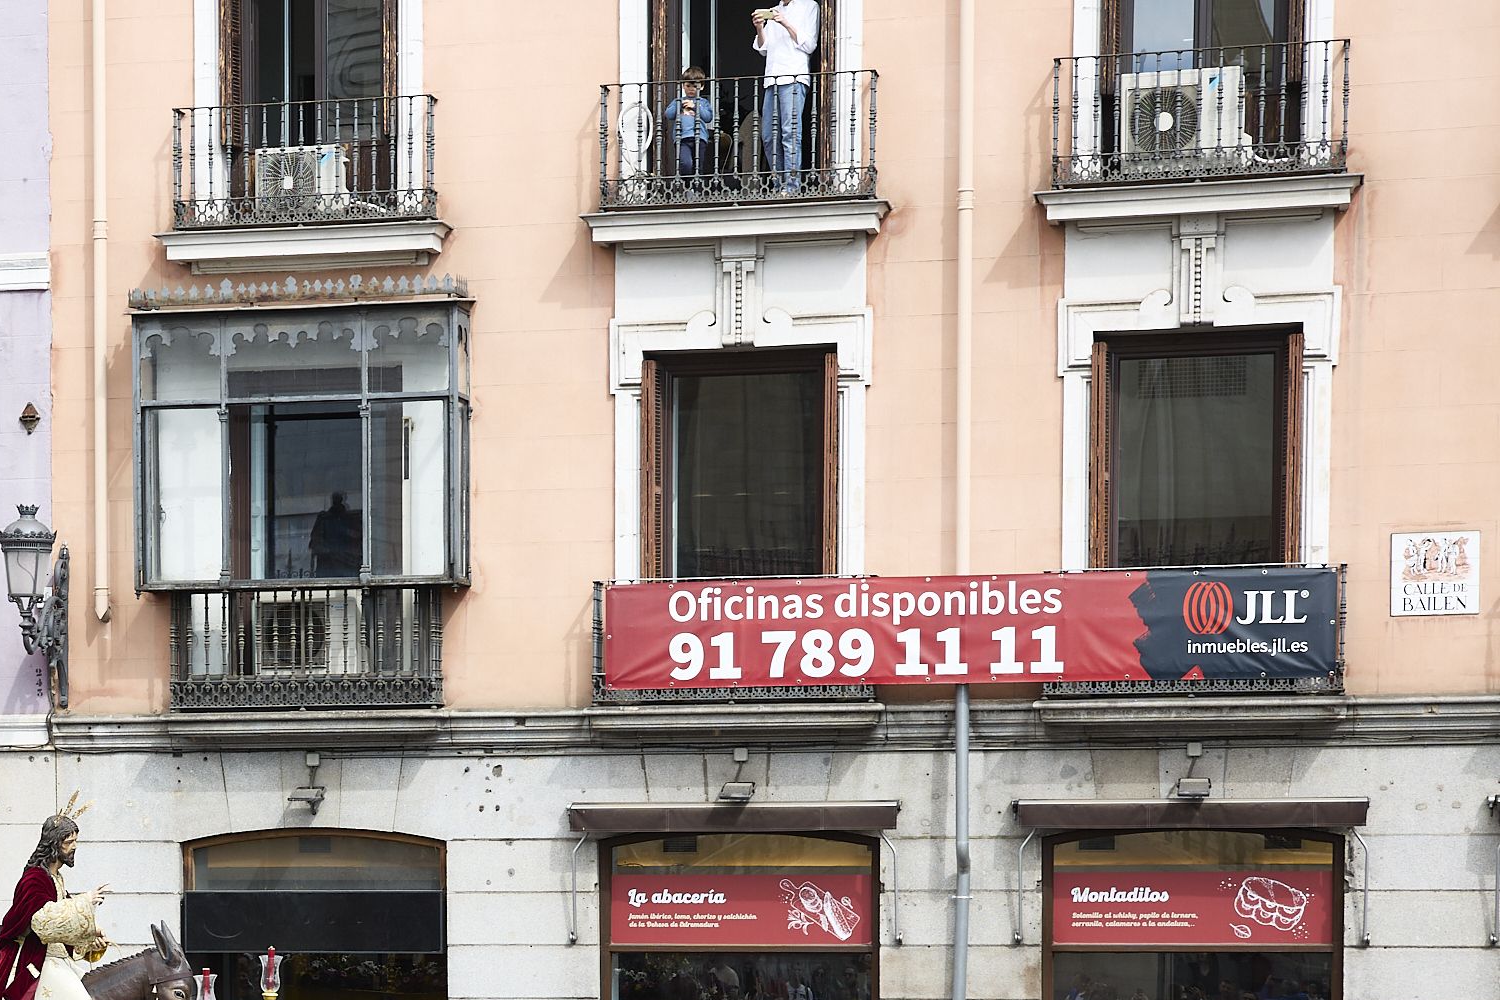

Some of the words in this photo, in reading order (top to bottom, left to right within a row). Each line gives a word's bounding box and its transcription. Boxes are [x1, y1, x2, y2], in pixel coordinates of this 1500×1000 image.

[1403, 582, 1450, 595] CALLE
[1453, 583, 1468, 593] DE
[668, 587, 824, 623] Oficinas
[834, 581, 1063, 626] disponibles
[668, 631, 742, 681] 91
[761, 627, 876, 678] 789
[895, 626, 969, 676] 11
[990, 624, 1065, 675] 11
[1186, 638, 1309, 657] inmuebles.jll.es
[628, 888, 648, 907] La
[651, 888, 727, 905] abacería
[1071, 886, 1170, 903] Montaditos
[628, 913, 649, 921] Jamón
[1139, 912, 1160, 920] pepito
